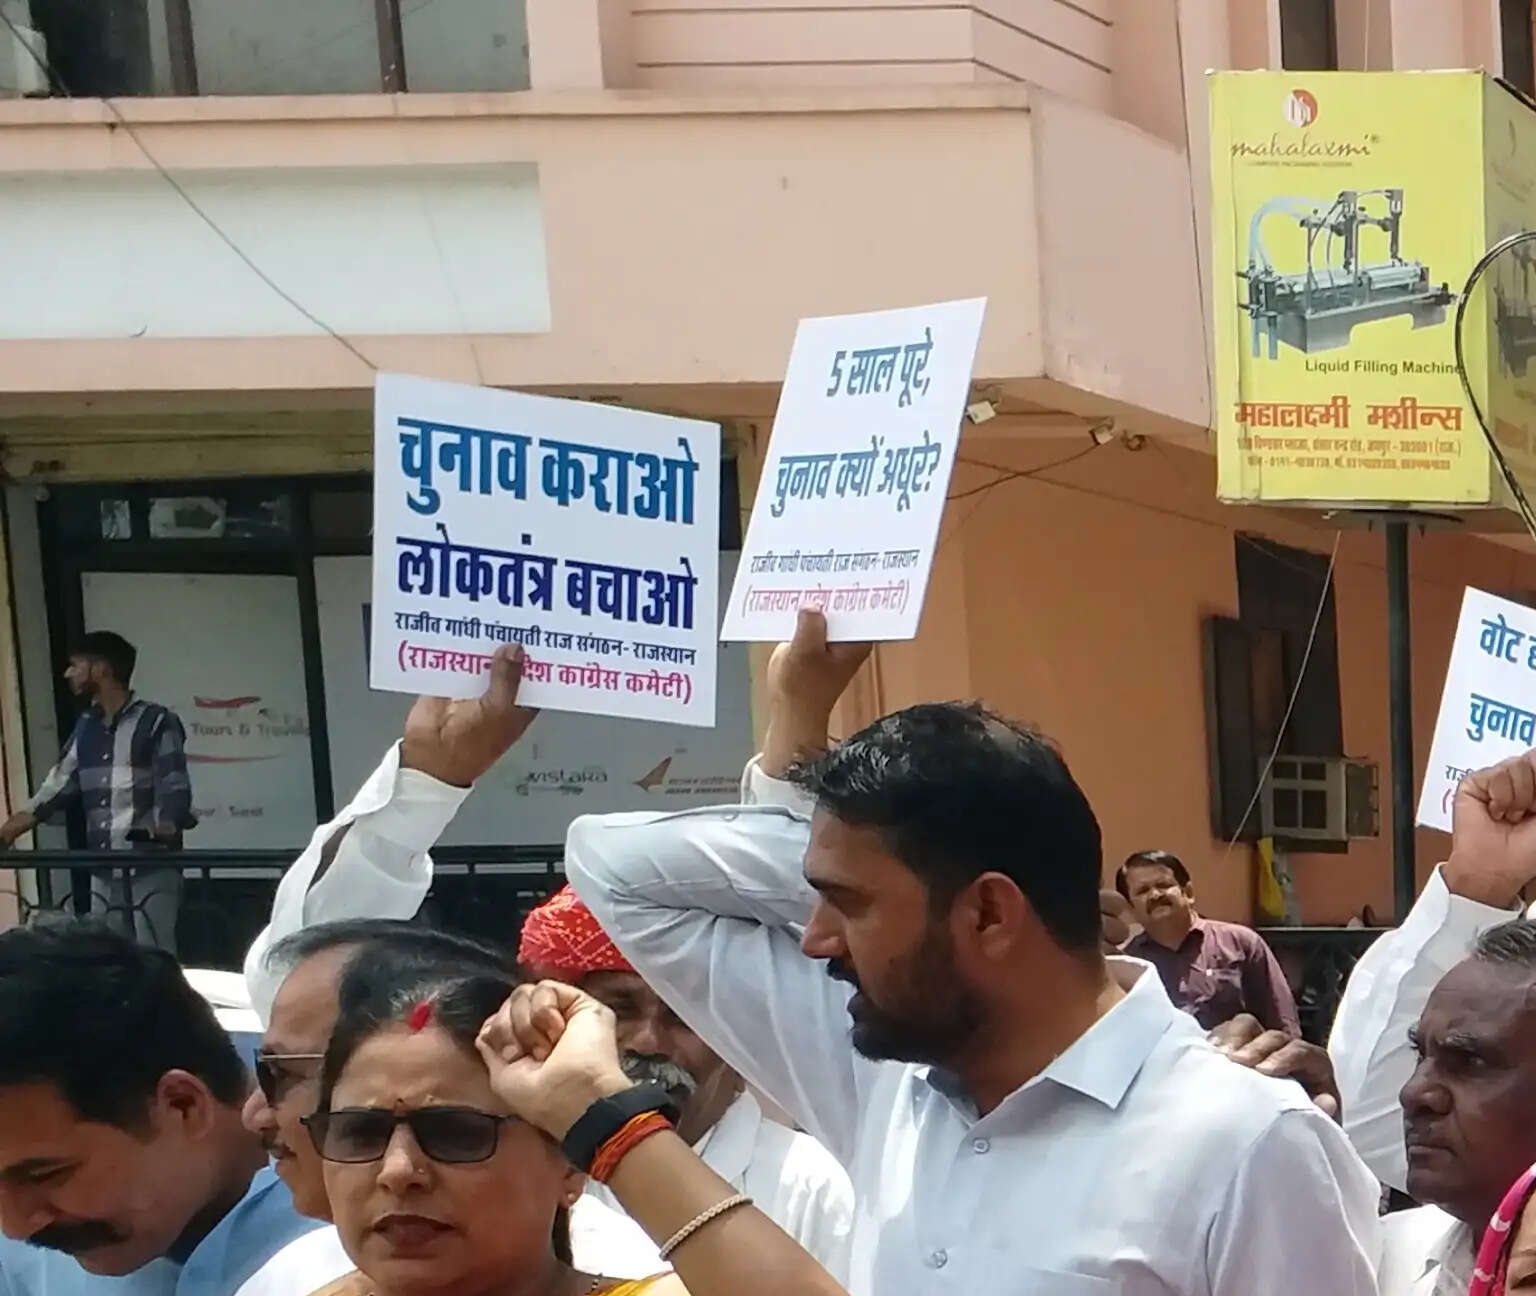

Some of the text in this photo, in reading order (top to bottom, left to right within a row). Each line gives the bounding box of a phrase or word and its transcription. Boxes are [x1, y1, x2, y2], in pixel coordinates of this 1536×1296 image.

[1231, 131, 1371, 158] mahalaxmi
[826, 327, 934, 408] 5 साल पूरे,
[1305, 359, 1350, 375] Liquid
[1355, 360, 1398, 376] Filling
[1234, 395, 1463, 431] महालक्ष्मी मशीन्स
[397, 416, 699, 525] चुनाव कराओ
[770, 430, 942, 518] चुनाव क्यों अधूरे?
[396, 523, 699, 630] लोकतंत्र बचाओ
[394, 611, 442, 635] राजीव
[443, 614, 481, 640] गांधी
[484, 620, 541, 648] पंचायती
[544, 631, 574, 651] राज
[632, 641, 697, 666] राजस्थान
[1479, 613, 1526, 664] वोट
[558, 658, 623, 692] कांग्रेस
[625, 669, 693, 705] कमेटी)
